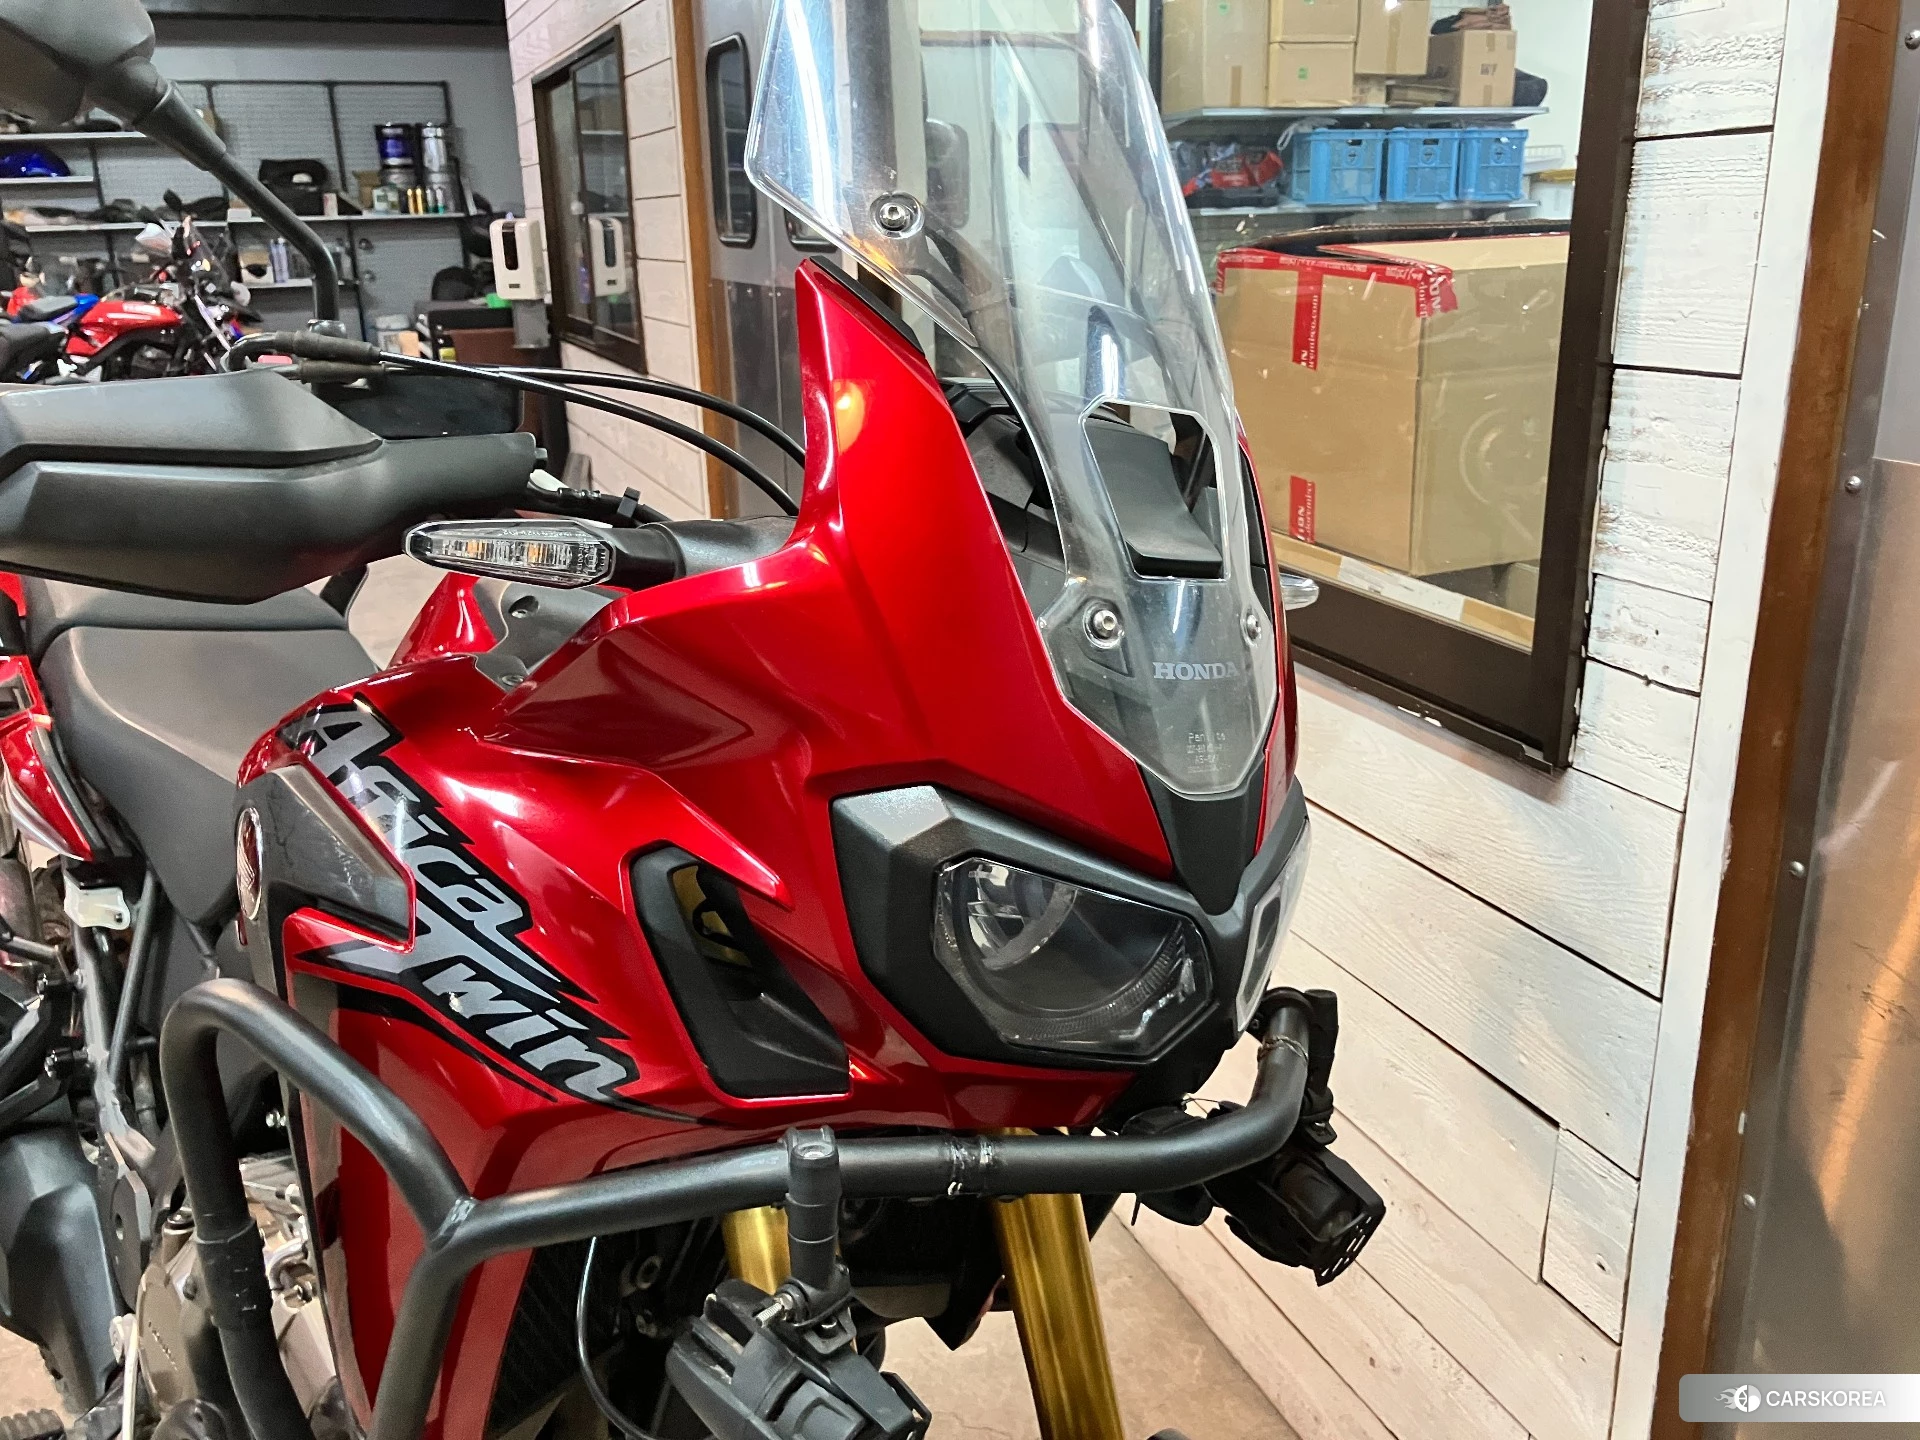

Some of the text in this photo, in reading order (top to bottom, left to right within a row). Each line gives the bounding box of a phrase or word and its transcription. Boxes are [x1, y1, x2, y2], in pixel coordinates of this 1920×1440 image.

[1152, 662, 1241, 680] HONDA
[284, 698, 561, 984] Africa
[325, 898, 630, 1100] Twin
